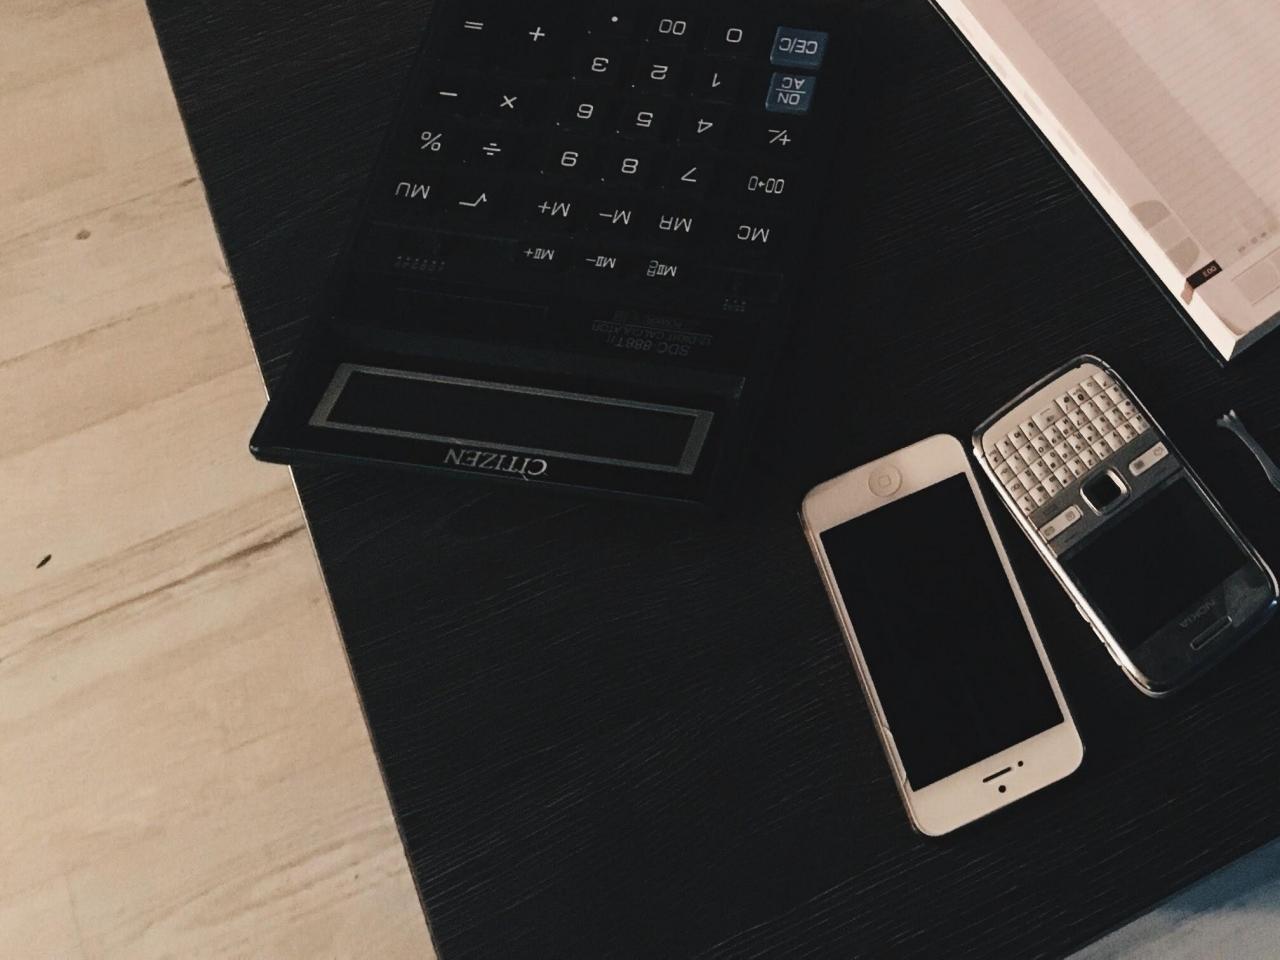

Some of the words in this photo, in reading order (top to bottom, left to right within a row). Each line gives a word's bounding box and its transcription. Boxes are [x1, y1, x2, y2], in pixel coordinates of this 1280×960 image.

[659, 19, 686, 35] 00
[726, 28, 743, 43] 0
[779, 38, 818, 54] CE/C
[591, 57, 609, 72] 3
[651, 65, 668, 80] 2
[712, 73, 720, 87] 1
[779, 76, 805, 91] AC
[777, 93, 802, 106] ON
[577, 104, 593, 119] 6
[636, 112, 653, 127] 5
[697, 119, 713, 133] 4
[421, 131, 442, 151] %
[561, 151, 579, 167] 9
[621, 158, 639, 174] 8
[681, 167, 696, 182] 7
[395, 182, 430, 199] MU
[659, 215, 692, 232] MR
[737, 225, 770, 243] MC
[445, 445, 549, 480] CITIZEN
